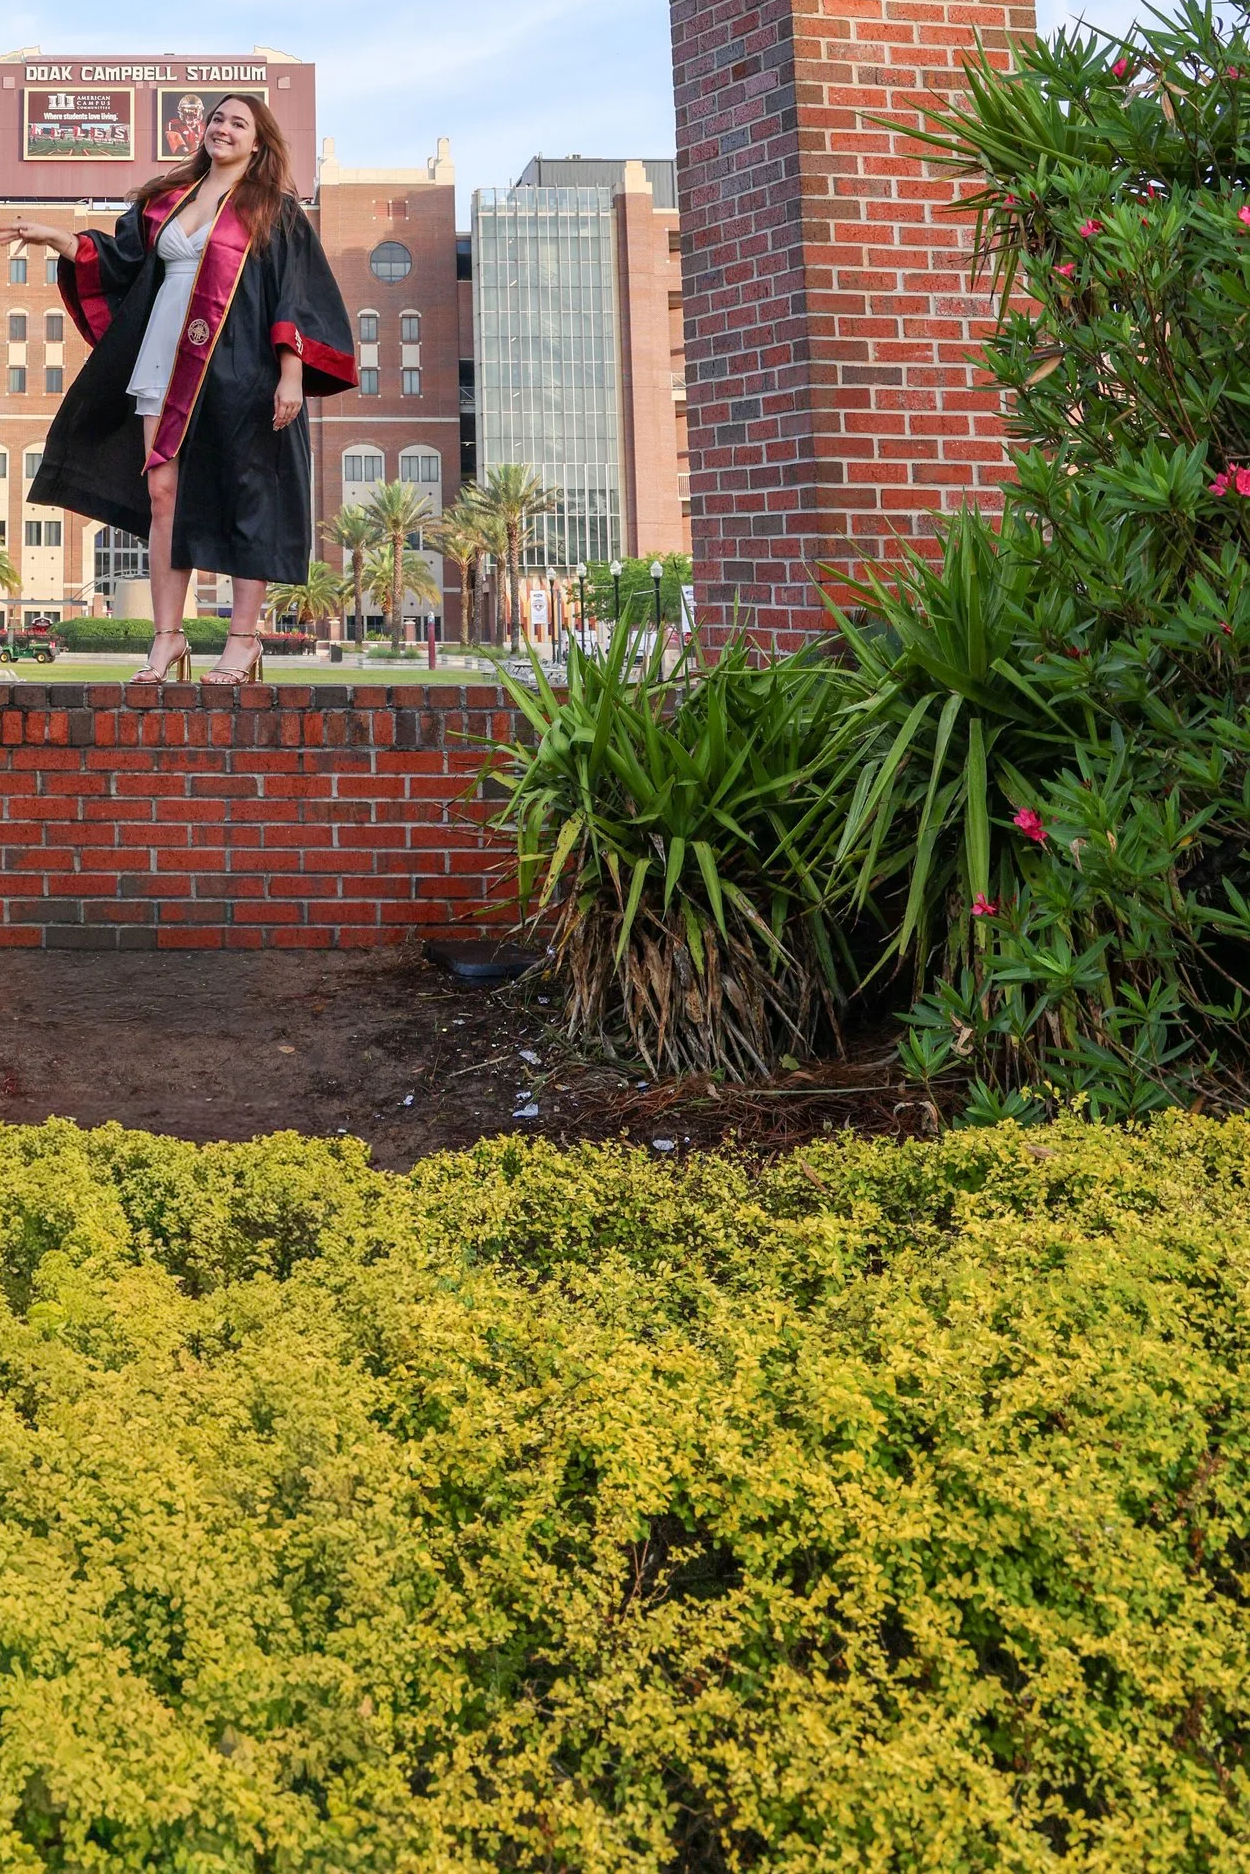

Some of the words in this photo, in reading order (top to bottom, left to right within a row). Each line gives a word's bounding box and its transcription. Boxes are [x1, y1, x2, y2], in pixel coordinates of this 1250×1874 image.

[26, 66, 73, 81] DOAK
[81, 66, 177, 81] CAMPBELL
[186, 66, 267, 81] STADIUM
[43, 112, 63, 120] Where
[63, 112, 88, 120] students
[88, 112, 100, 120] love
